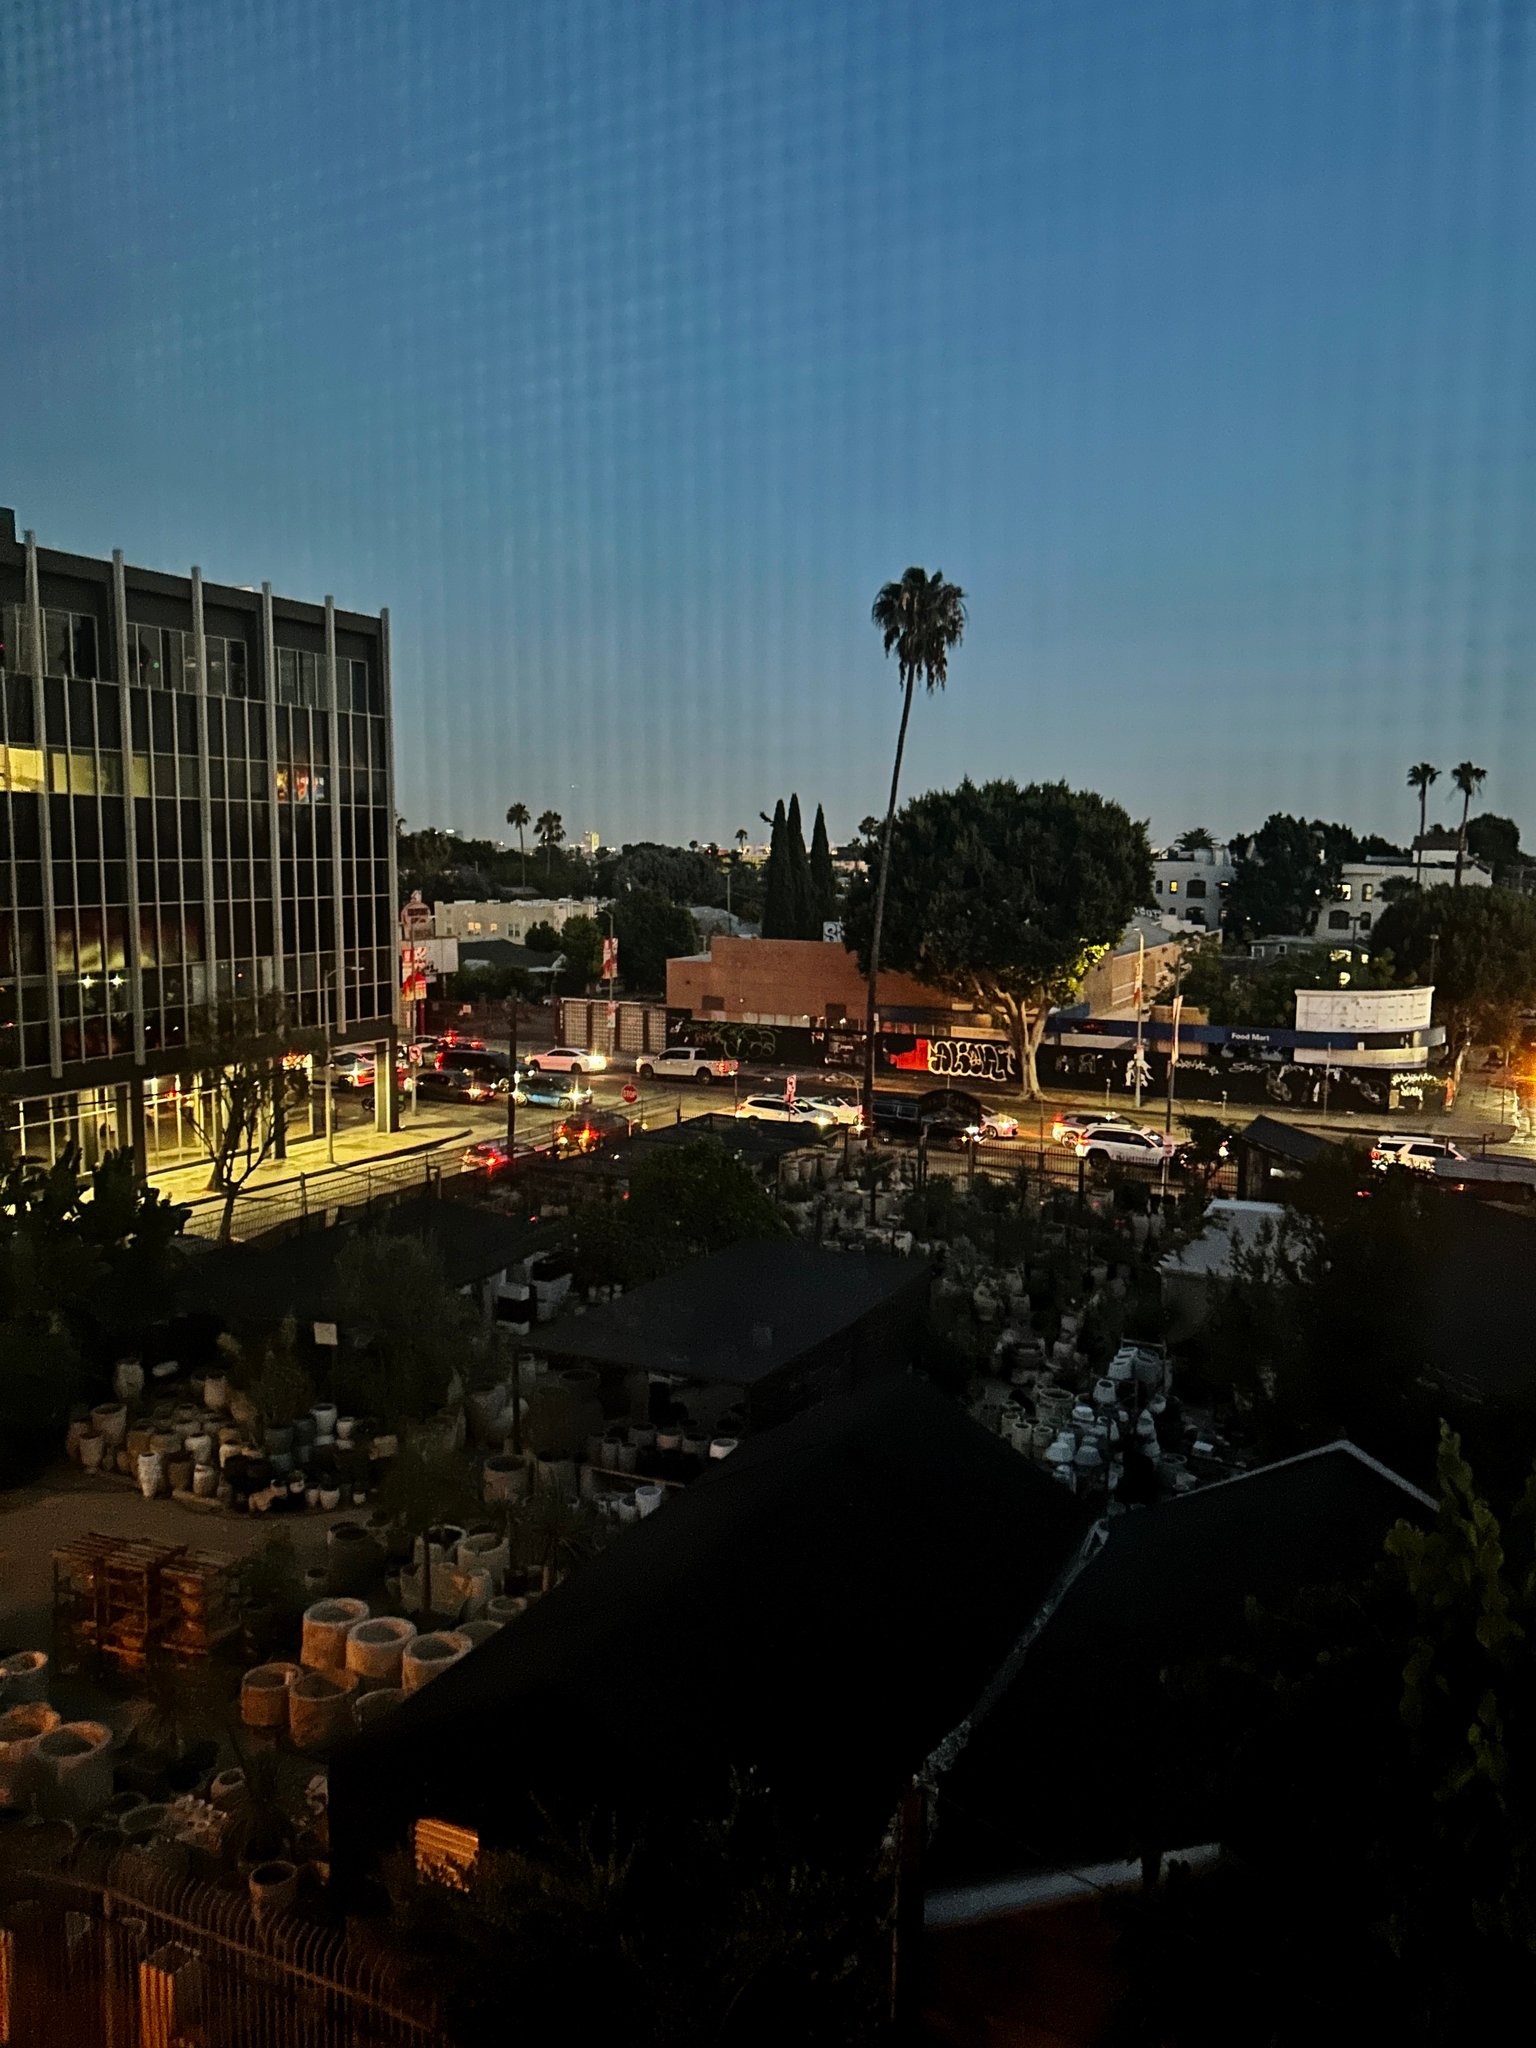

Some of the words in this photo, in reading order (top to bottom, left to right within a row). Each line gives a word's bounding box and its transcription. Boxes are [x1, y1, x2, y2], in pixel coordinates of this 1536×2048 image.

[1231, 1032, 1250, 1040] Food
[1251, 1033, 1270, 1041] Mart
[623, 1089, 637, 1098] STOP
